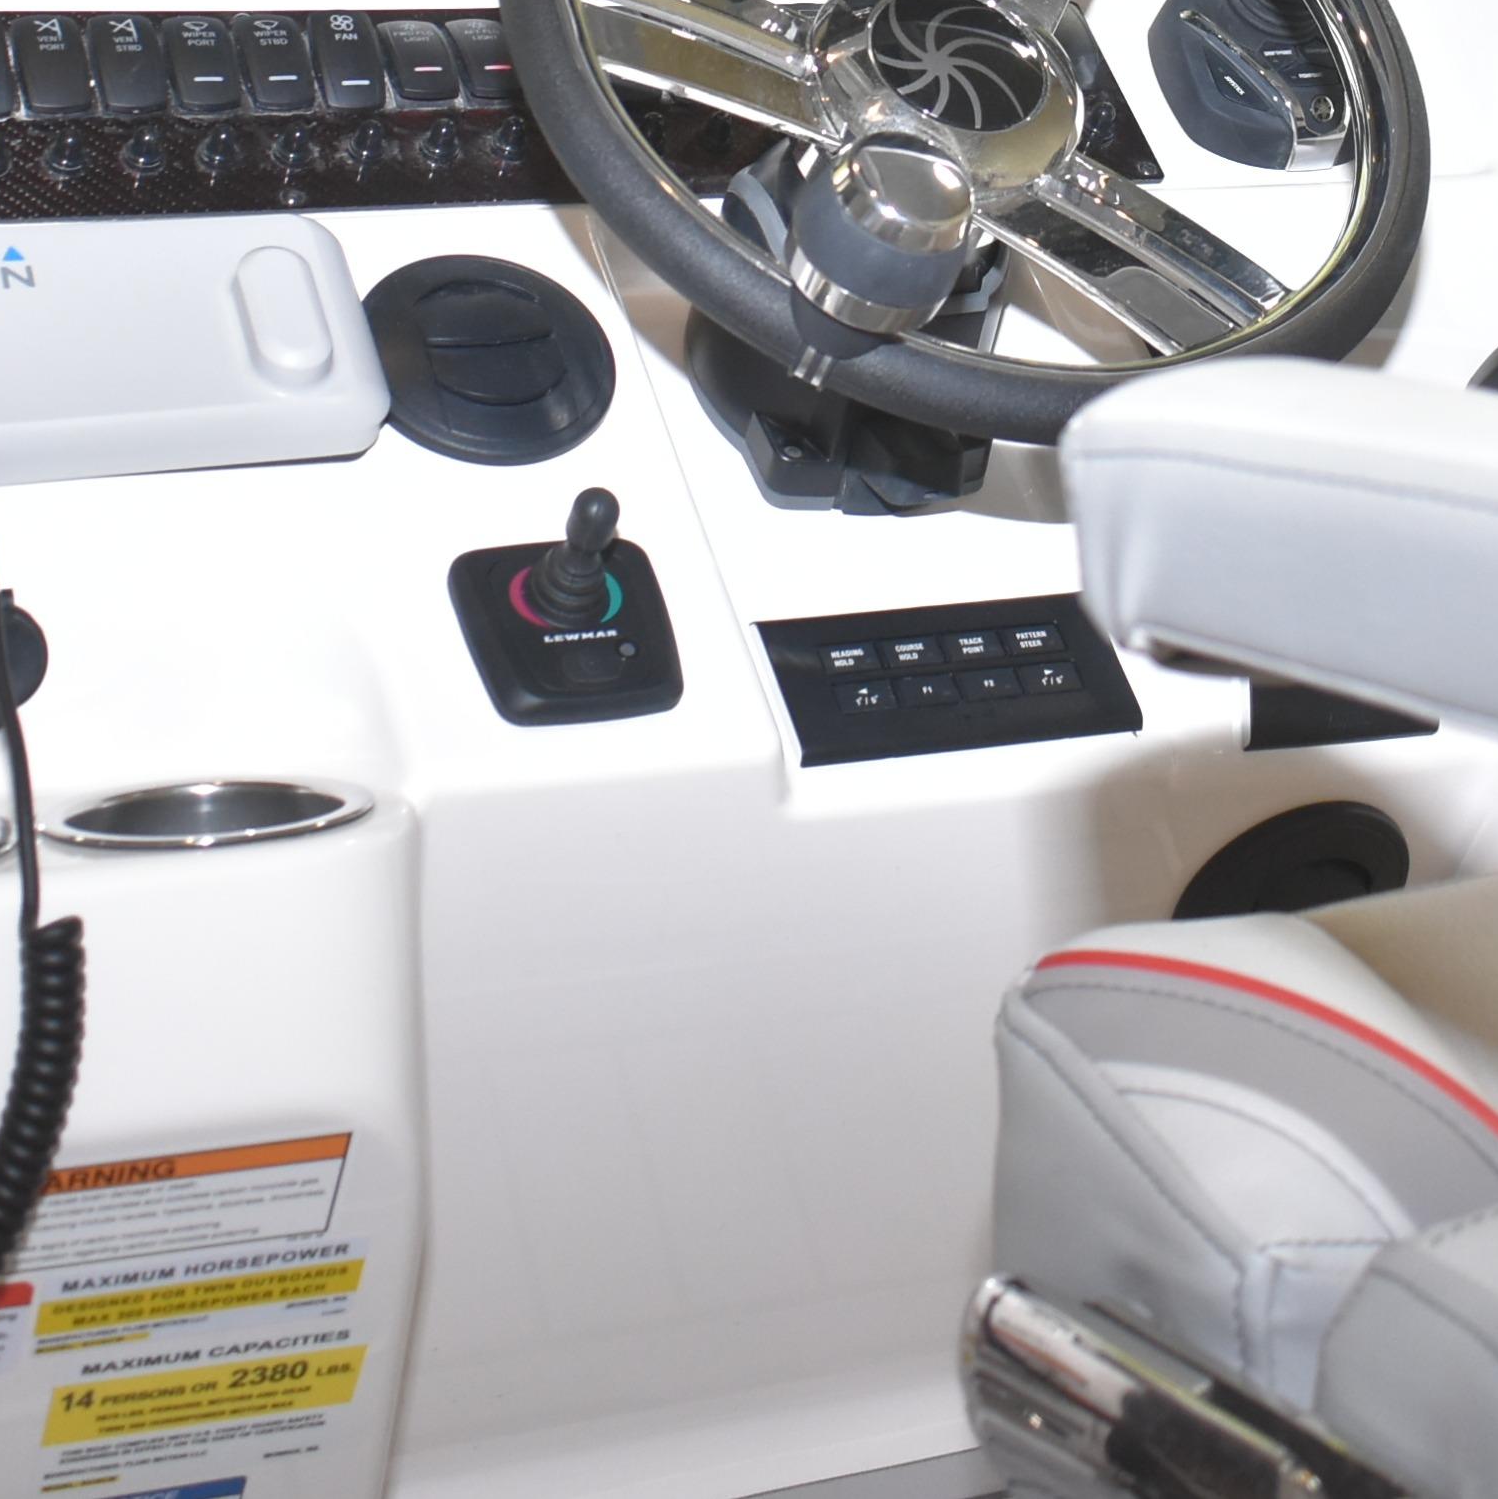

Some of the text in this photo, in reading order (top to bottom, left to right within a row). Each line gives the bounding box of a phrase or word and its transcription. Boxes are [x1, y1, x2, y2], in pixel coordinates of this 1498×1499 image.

[335, 32, 358, 41] FAN
[39, 43, 65, 51] PORT
[187, 38, 216, 46] PORT
[259, 38, 289, 46] STBD
[115, 44, 142, 52] STBD
[543, 629, 618, 643] LEWMAR
[1015, 630, 1047, 640] PATTERN
[958, 636, 983, 646] TRACK
[1020, 639, 1043, 649] STEER
[894, 642, 924, 653] COURSE
[962, 645, 984, 655] POINT
[830, 648, 864, 659] HEADING
[898, 652, 919, 662] HOLD
[834, 658, 855, 668] HOLD
[922, 686, 933, 694] F1
[44, 1159, 177, 1195] ARNING
[61, 1243, 350, 1292] MAXIMUM HORSEPOWER
[52, 1266, 349, 1315] DESIGNED FOR TWIN OUTBOARDS
[72, 1313, 110, 1326] MAX
[149, 1290, 273, 1315] HORSEPOWER
[279, 1283, 326, 1297] EACH
[81, 1328, 350, 1376] MAXIMUM CAPACITIES
[60, 1359, 356, 1413] 14 PERSONS OR 2380 LBS.
